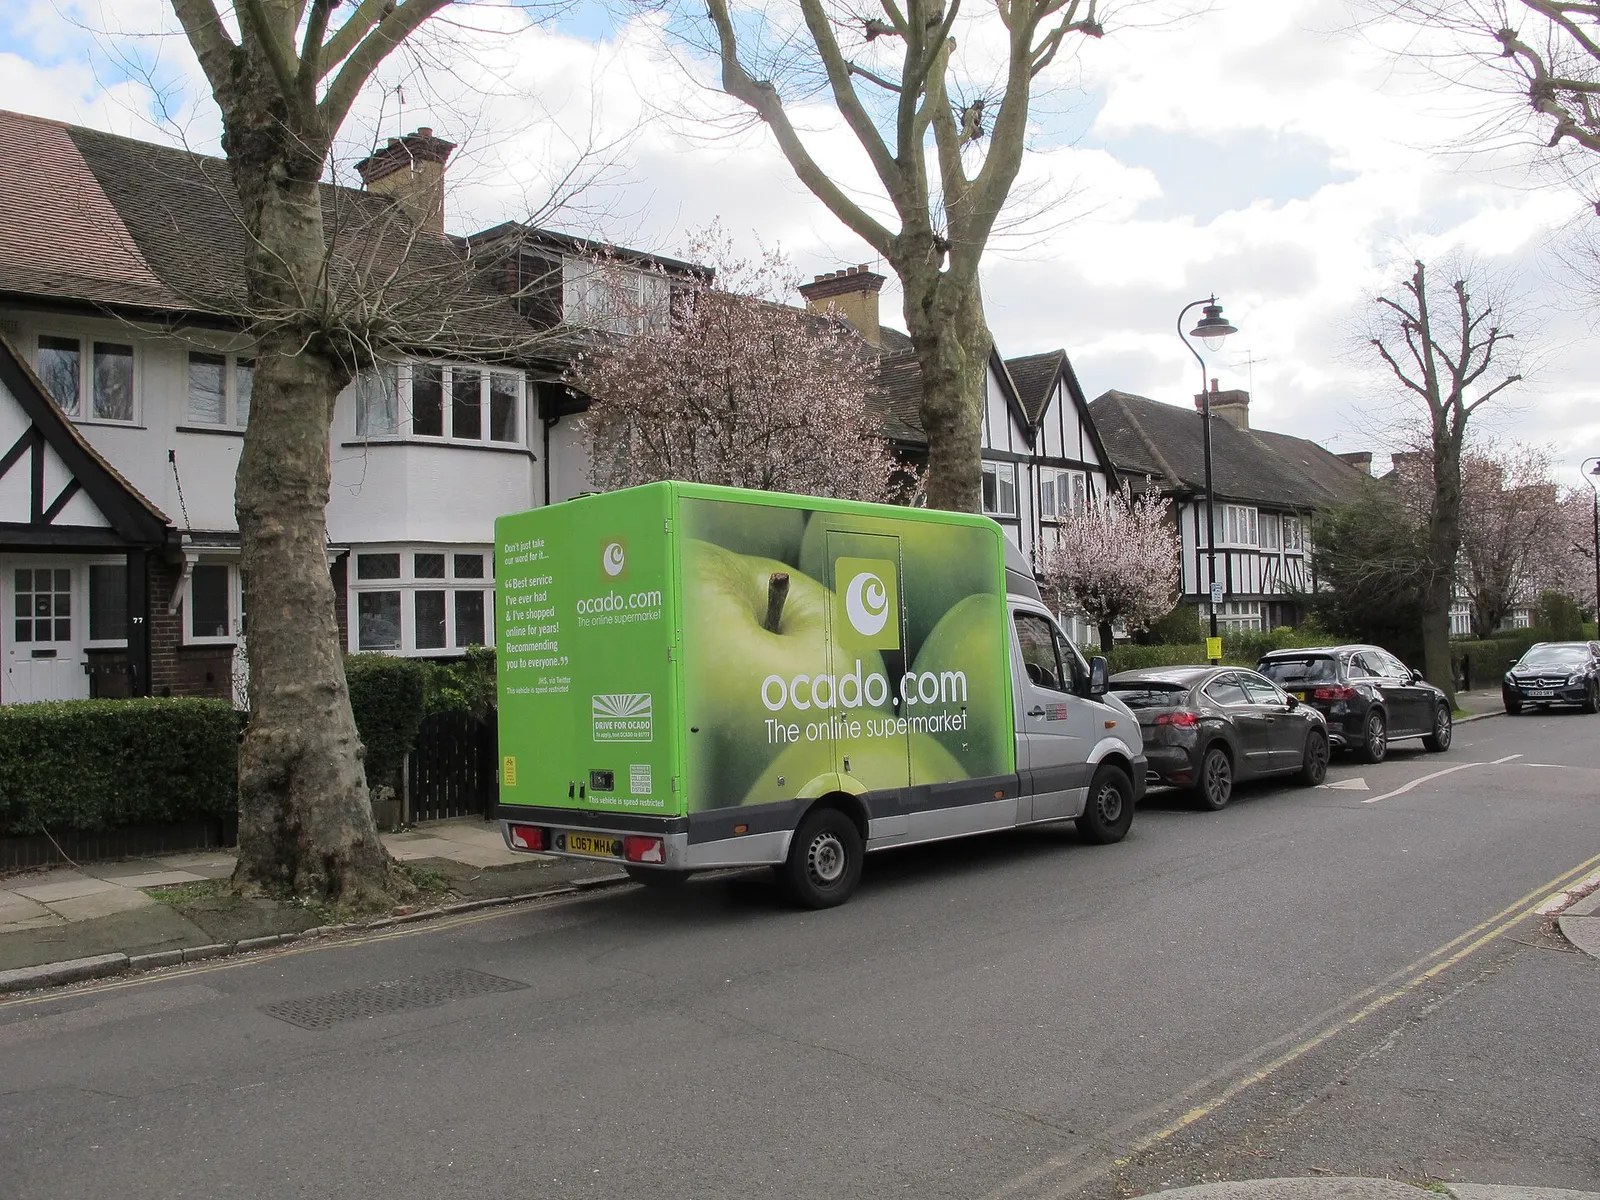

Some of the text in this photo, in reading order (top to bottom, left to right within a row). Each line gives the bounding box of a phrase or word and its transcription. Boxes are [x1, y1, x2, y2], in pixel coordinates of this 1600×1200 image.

[520, 540, 530, 552] just
[532, 538, 544, 548] take
[515, 552, 528, 563] word
[530, 552, 538, 561] for
[529, 574, 552, 586] service
[518, 594, 532, 604] ever
[534, 590, 547, 602] had
[576, 590, 662, 614] ocado.com
[526, 606, 554, 620] shopped
[578, 608, 660, 627] The online supermarket
[506, 622, 559, 638] online for years!
[506, 639, 558, 652] Recommending
[506, 660, 518, 672] you
[520, 658, 526, 668] to
[761, 659, 967, 712] ocado.com
[595, 720, 650, 730] DRIVE FOR OCADO
[765, 710, 967, 743] The online supermarket
[588, 796, 599, 804] This
[600, 797, 616, 805] vehicle
[624, 798, 638, 806] speed
[640, 799, 664, 807] restricted
